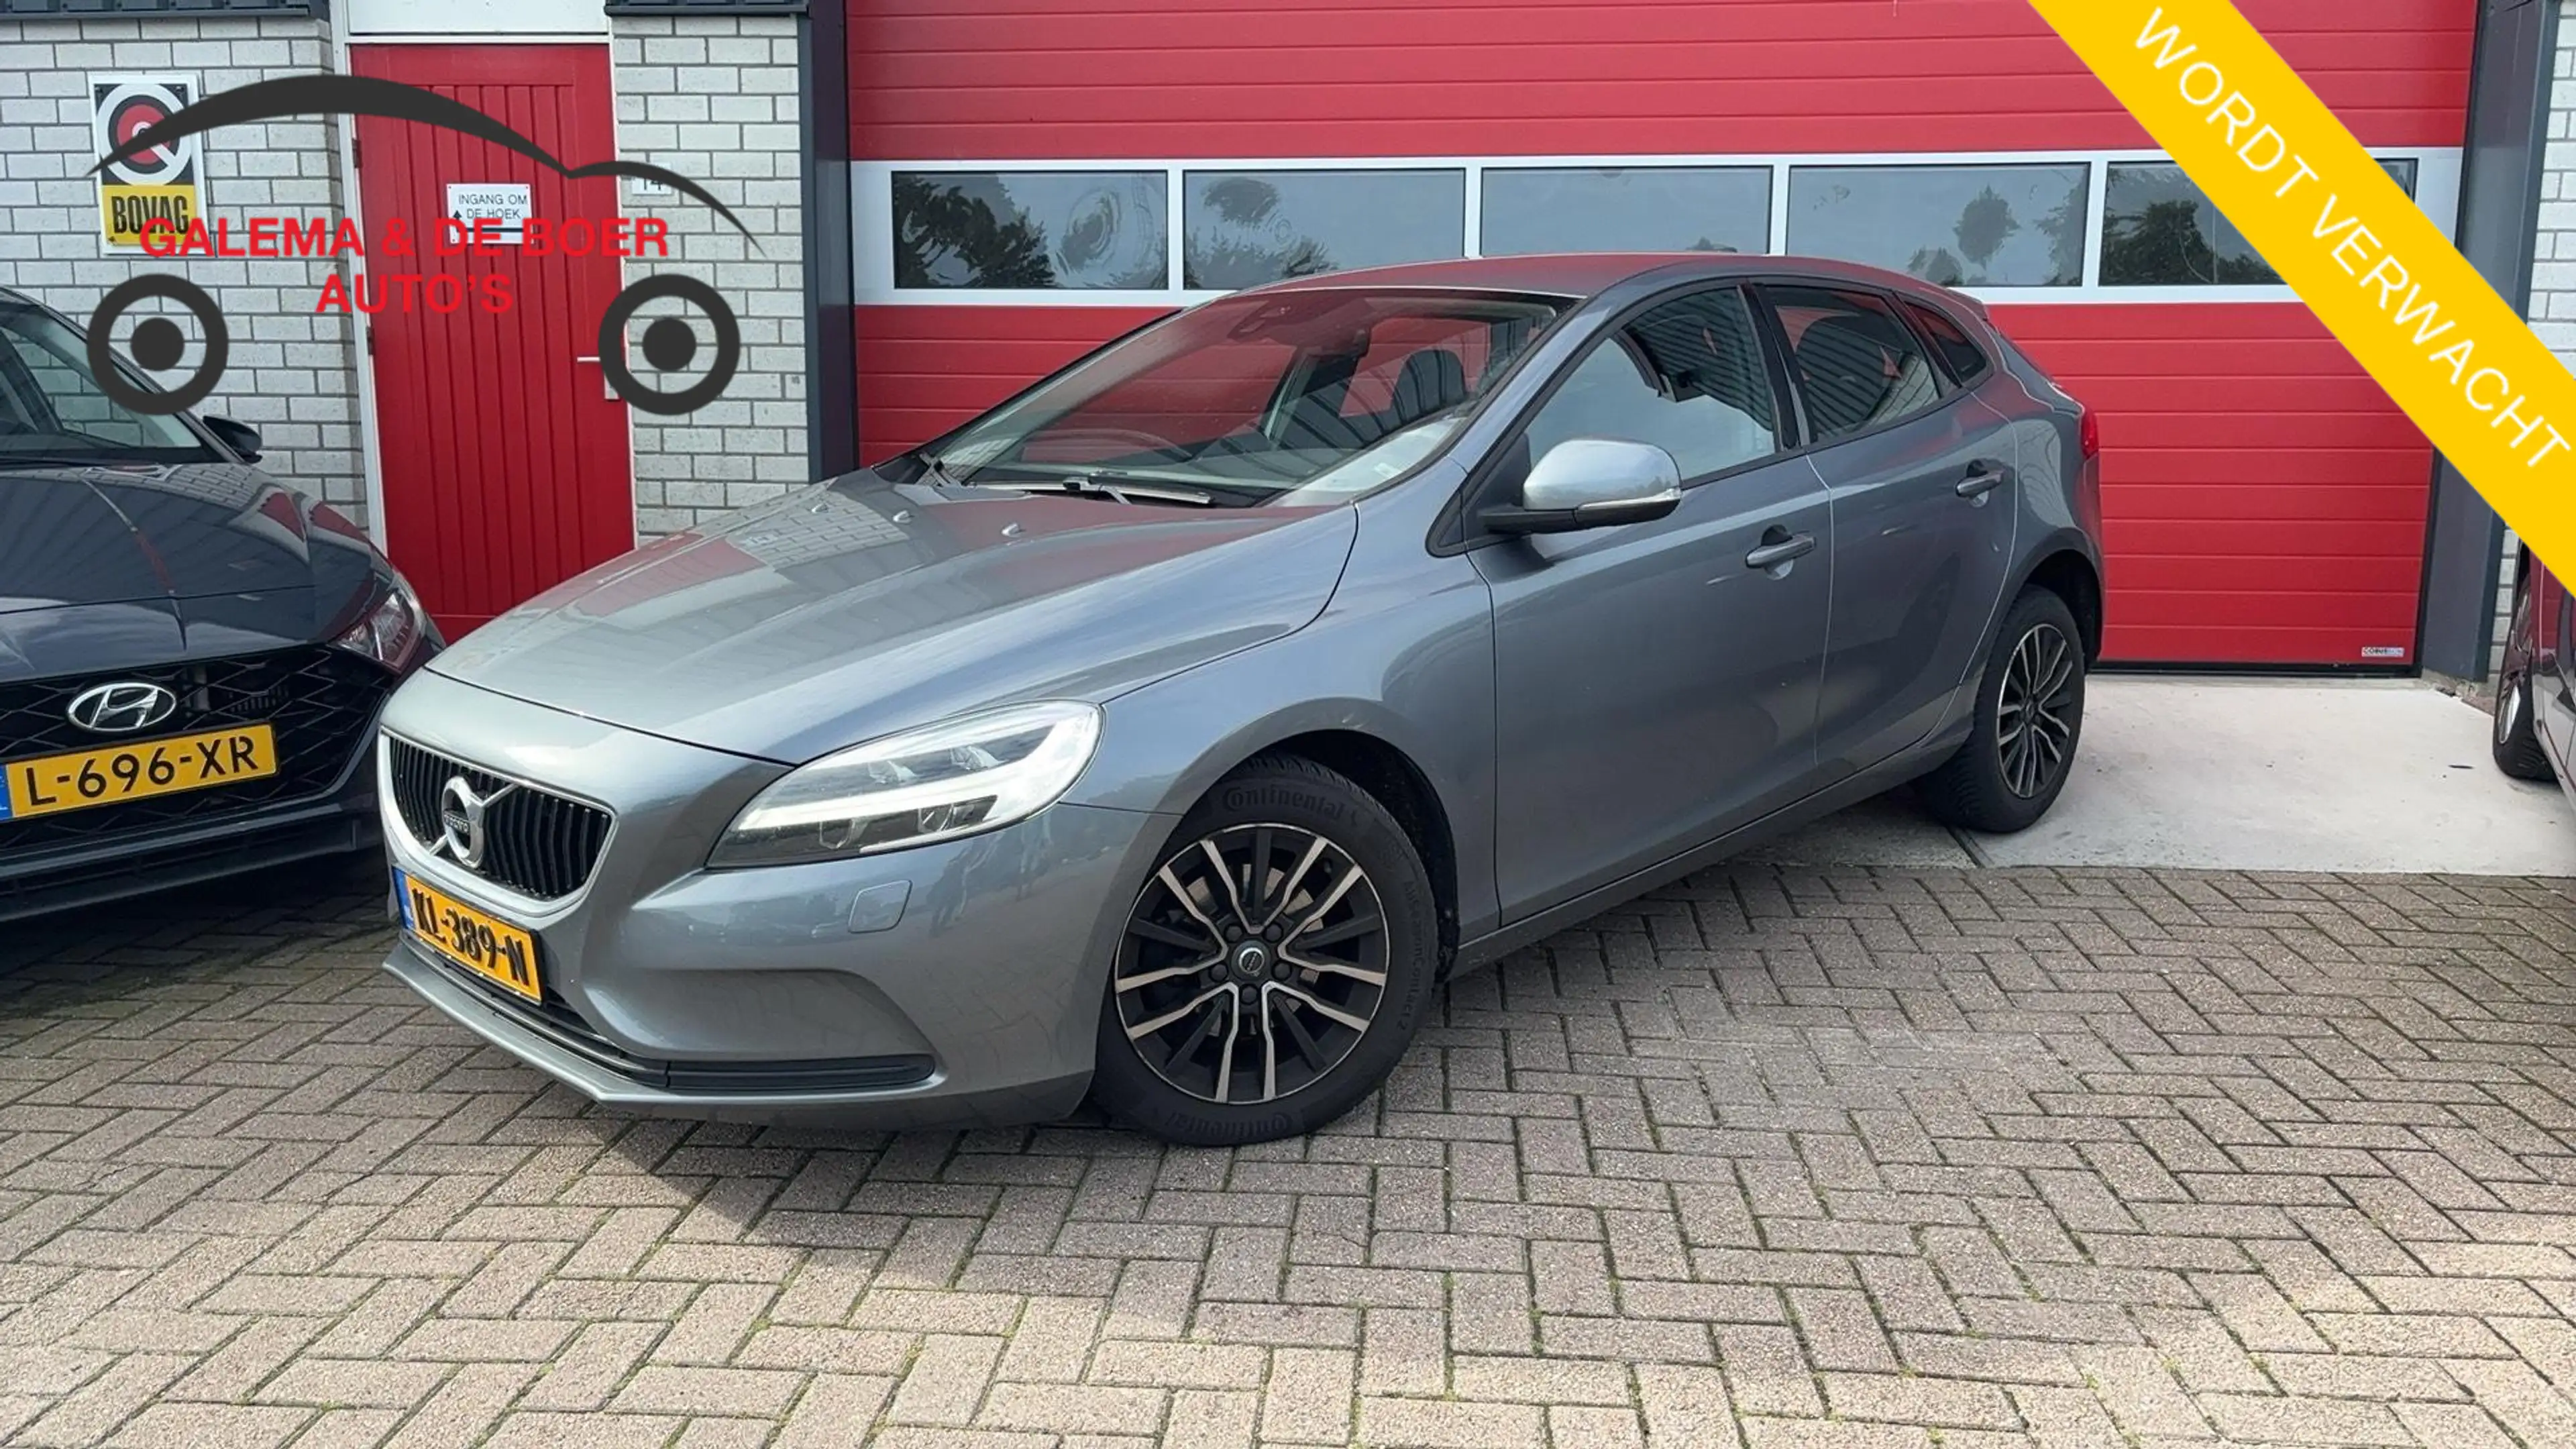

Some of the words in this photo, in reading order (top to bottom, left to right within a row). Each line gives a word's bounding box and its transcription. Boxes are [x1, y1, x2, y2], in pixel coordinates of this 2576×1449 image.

[111, 195, 189, 234] BOVAG
[459, 193, 504, 205] INGANG
[508, 194, 527, 205] OM
[466, 209, 482, 219] DE
[487, 209, 521, 219] HOEK
[26, 736, 258, 806] L-696-XR
[1225, 786, 1344, 818] Continental
[412, 888, 529, 986] KL-389-N
